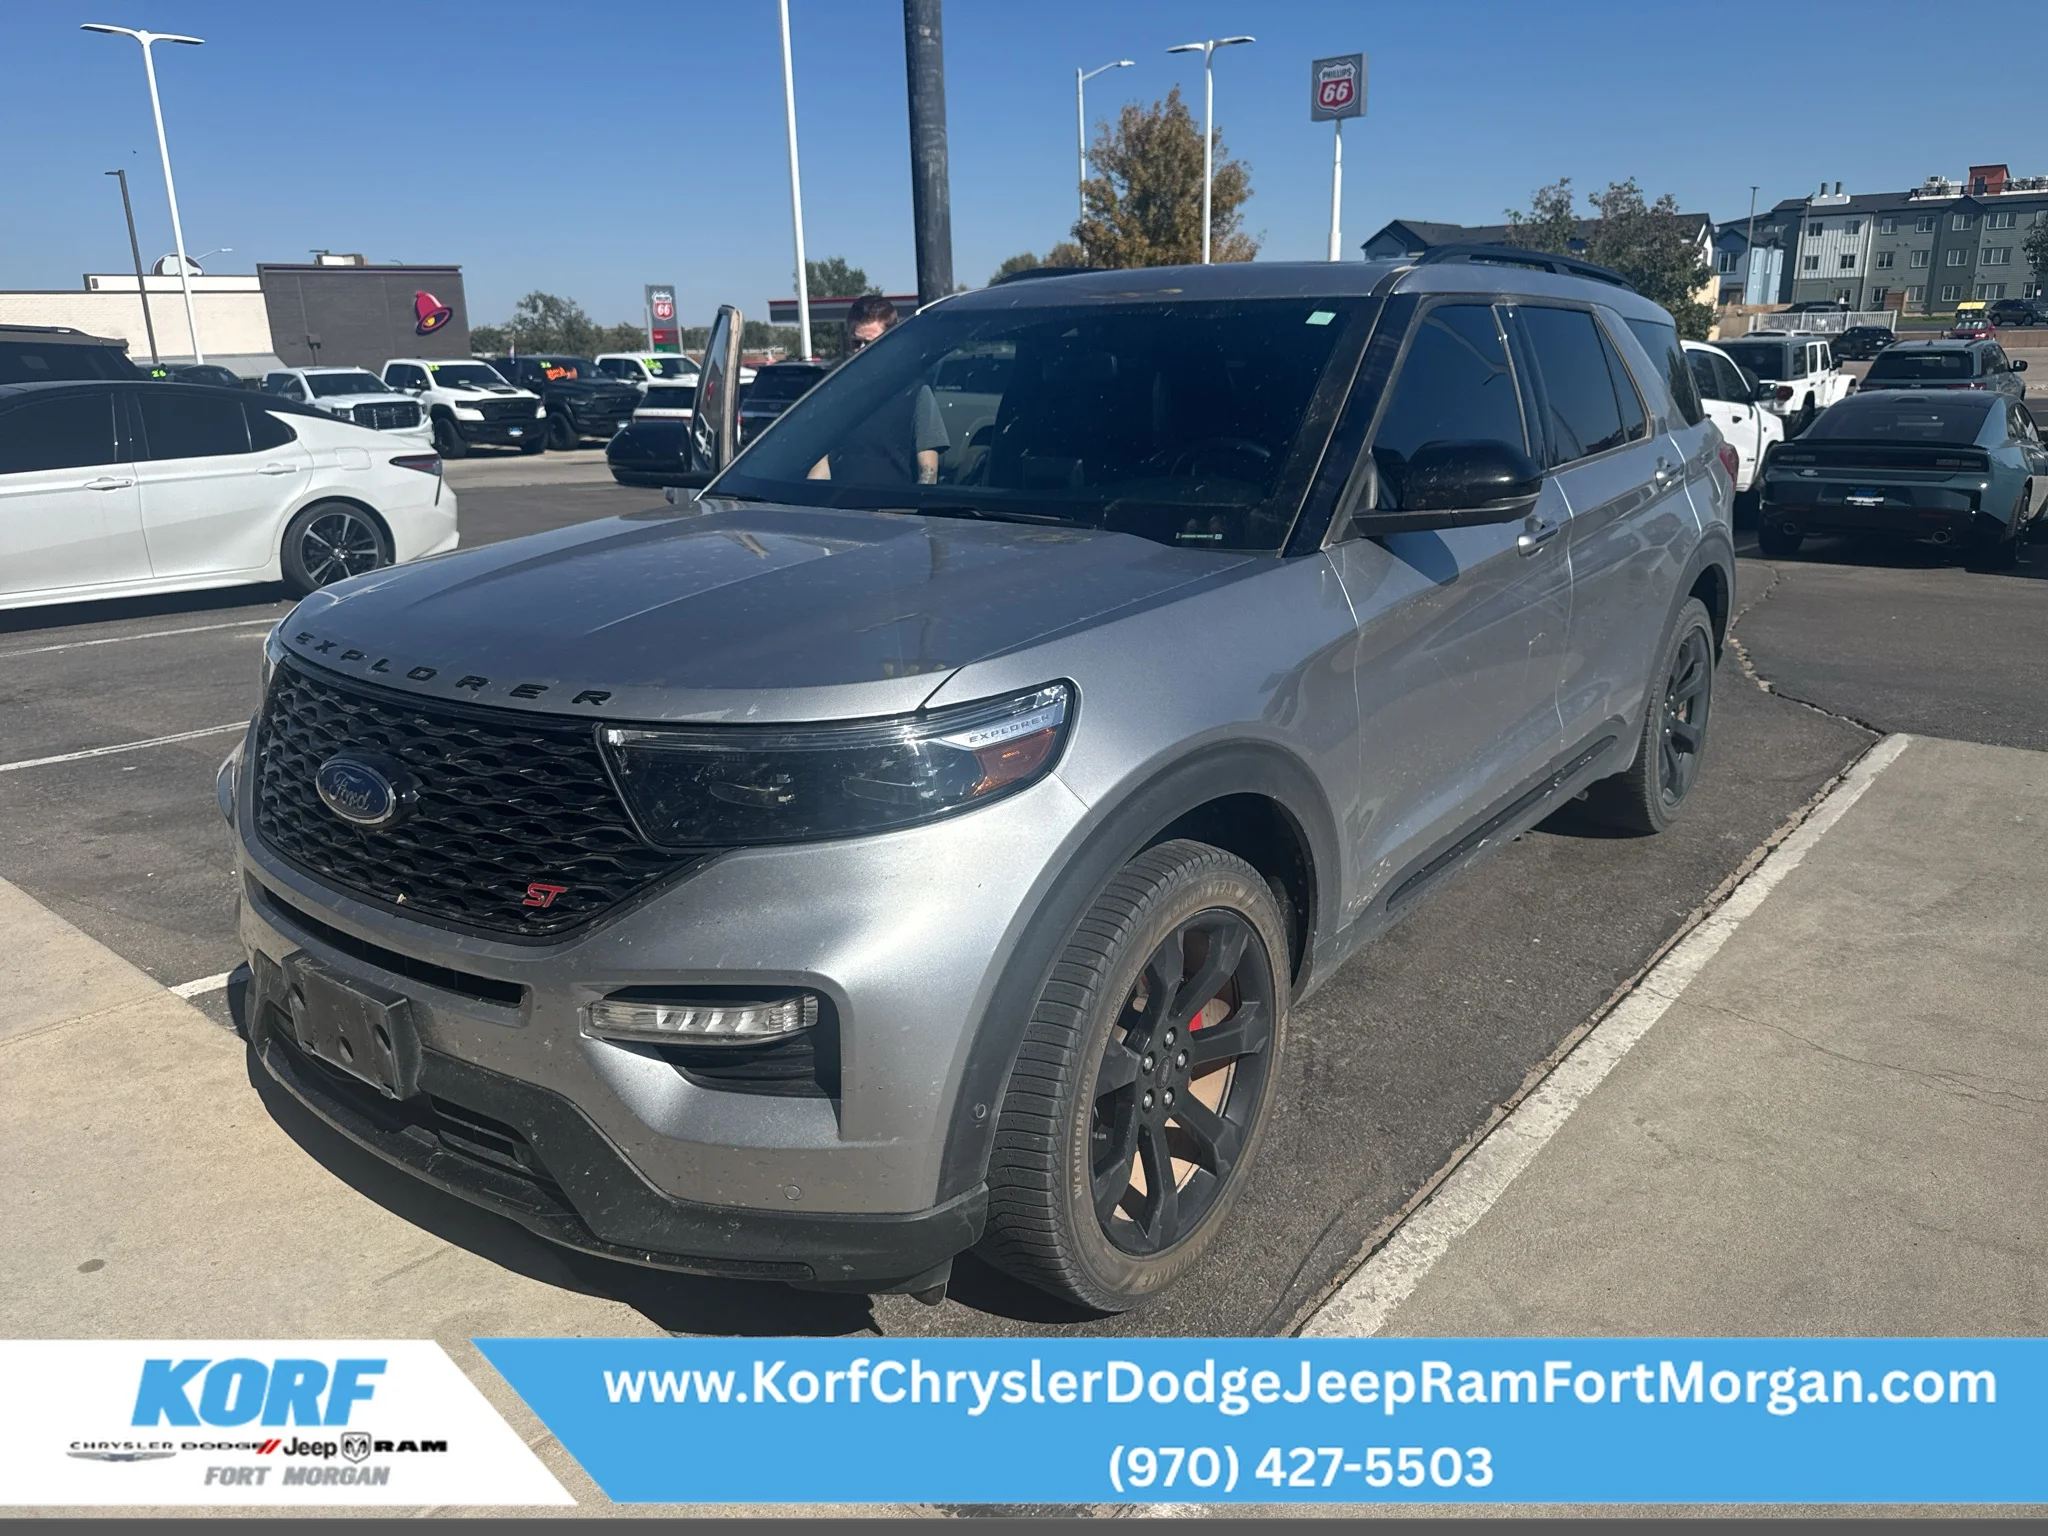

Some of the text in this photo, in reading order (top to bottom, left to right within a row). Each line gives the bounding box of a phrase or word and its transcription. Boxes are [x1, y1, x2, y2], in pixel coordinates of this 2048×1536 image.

[1321, 67, 1352, 79] PHILLIPS
[1323, 81, 1350, 103] 66
[657, 304, 671, 316] 66
[151, 369, 167, 378] 26
[295, 631, 613, 707] EXPLORER
[968, 714, 1050, 743] EXPLORER
[329, 771, 372, 811] Ford
[522, 883, 568, 909] ST
